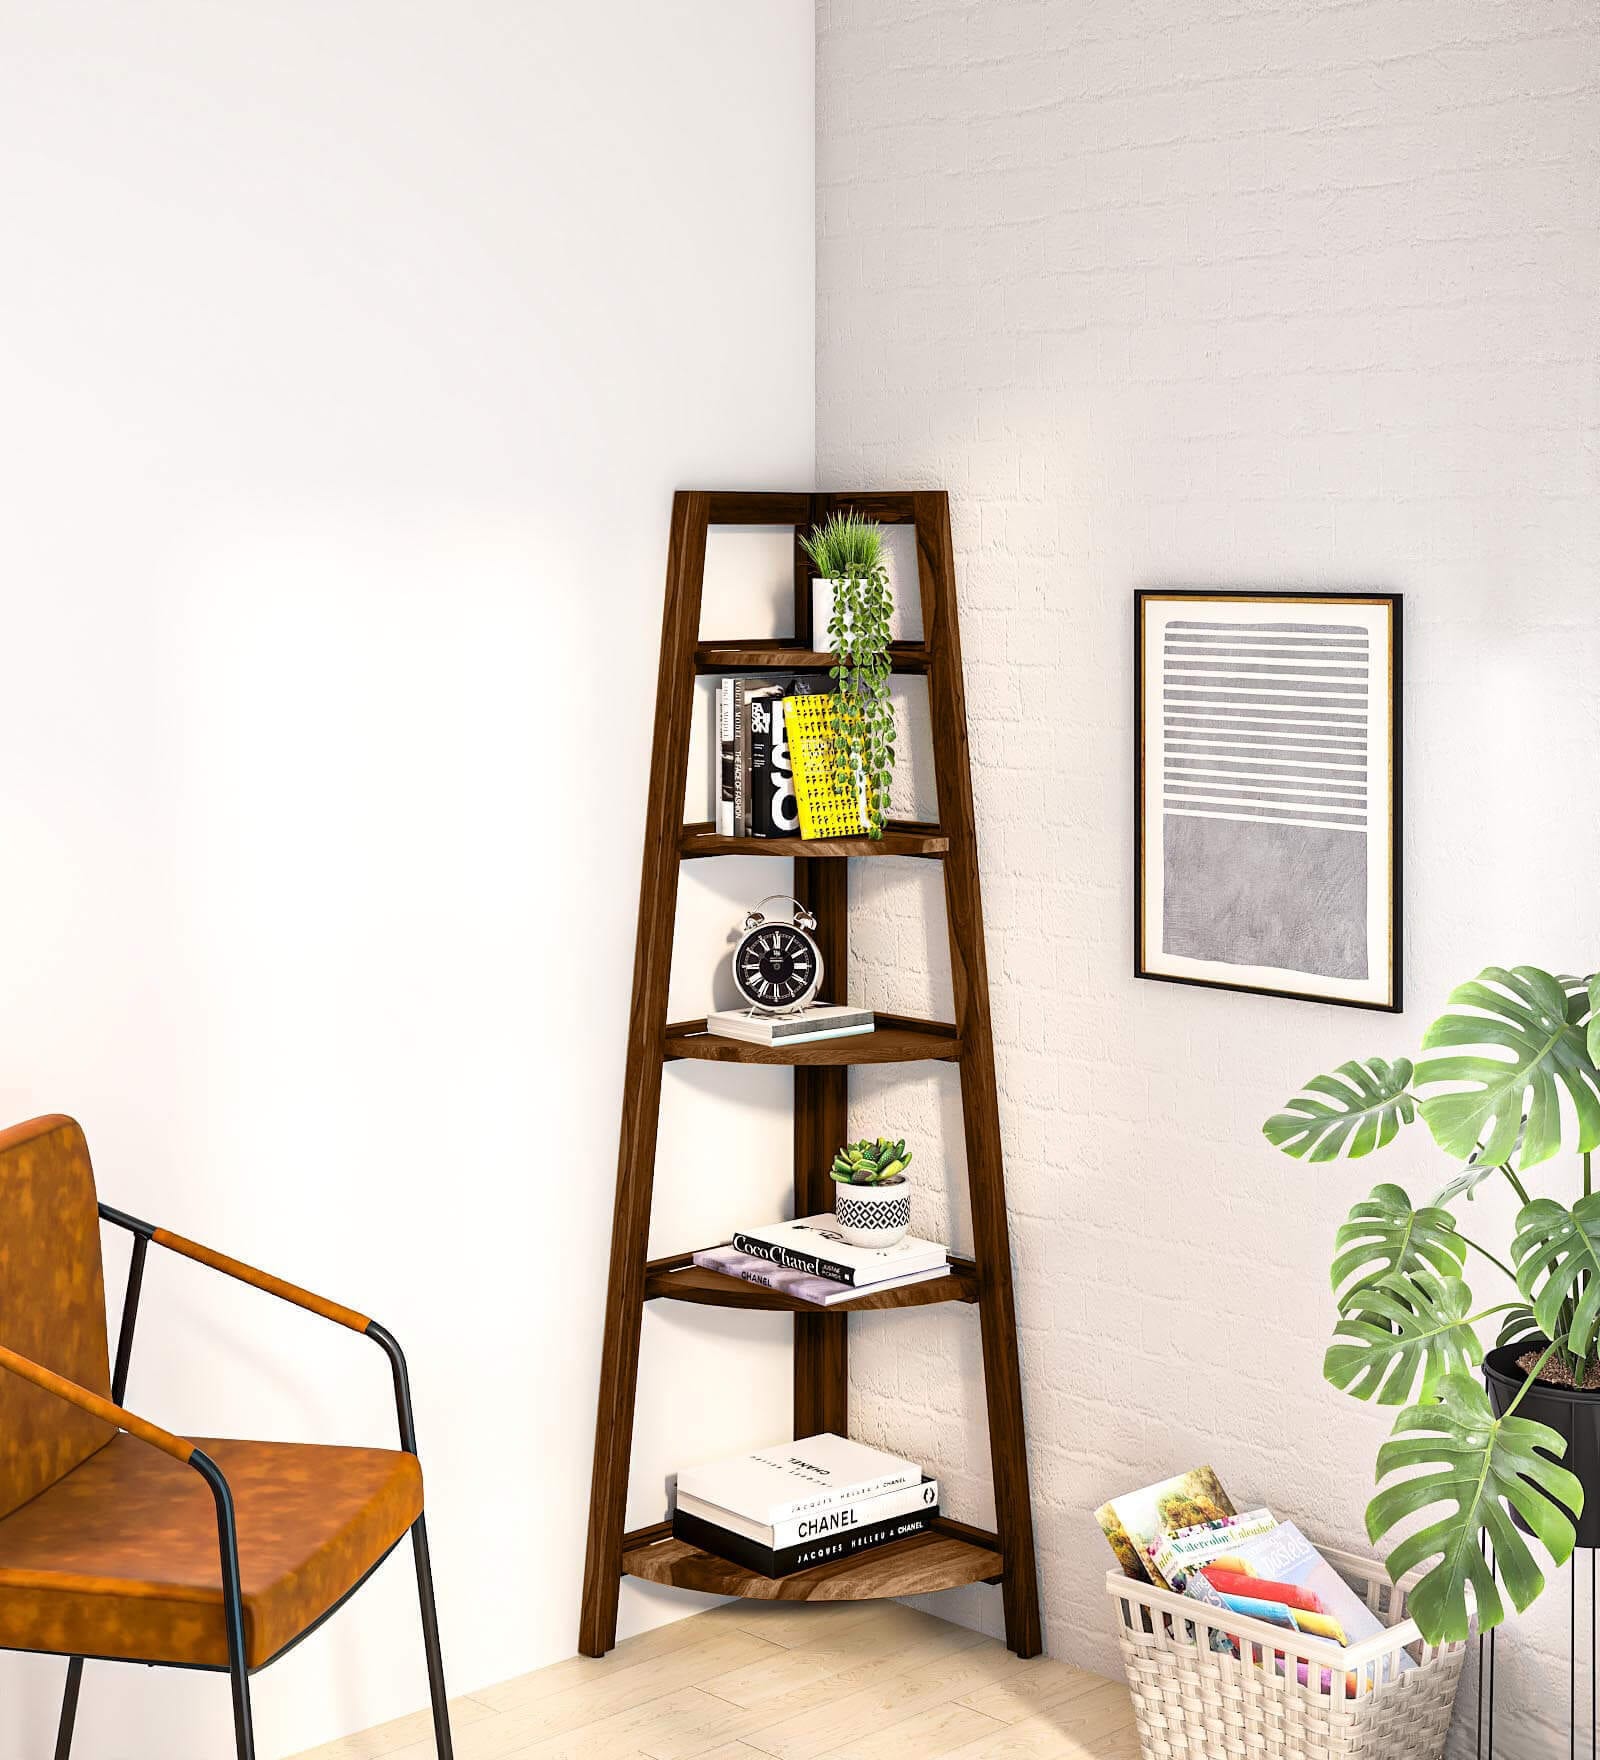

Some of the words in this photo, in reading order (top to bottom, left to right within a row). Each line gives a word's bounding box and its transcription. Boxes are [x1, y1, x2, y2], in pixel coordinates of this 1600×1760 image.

[735, 780, 742, 790] OF
[734, 1235, 769, 1259] Coco
[769, 1246, 821, 1276] Chanel
[741, 1271, 772, 1287] CHANEL
[788, 1457, 831, 1476] CHANEL
[883, 1477, 906, 1488] CHANEL
[798, 1508, 858, 1538] CHANEL
[797, 1543, 843, 1564] JACQUES
[851, 1531, 885, 1549] HELLEU
[897, 1521, 924, 1535] CHANEL
[1172, 1533, 1230, 1555] Watercolor
